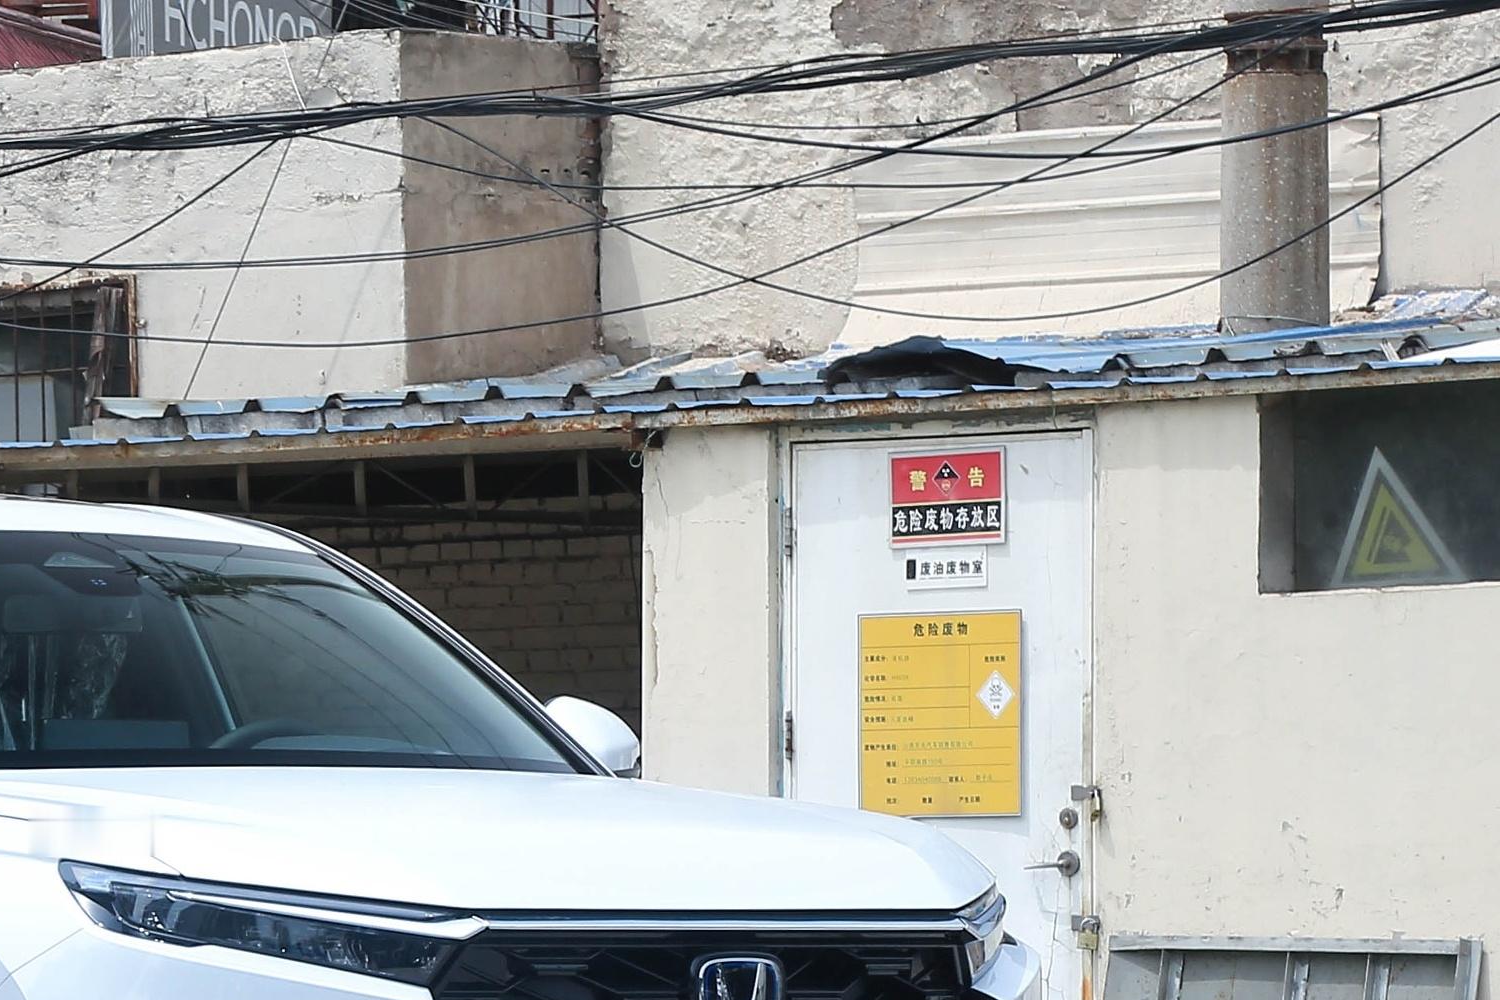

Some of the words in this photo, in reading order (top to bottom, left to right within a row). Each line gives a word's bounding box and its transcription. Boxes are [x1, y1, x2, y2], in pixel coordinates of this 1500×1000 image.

[909, 470, 927, 491] 警
[967, 467, 985, 488] 告
[893, 505, 1000, 533] 危险废物存放区
[920, 560, 983, 576] 废油废物室
[913, 623, 969, 637] 危险废物
